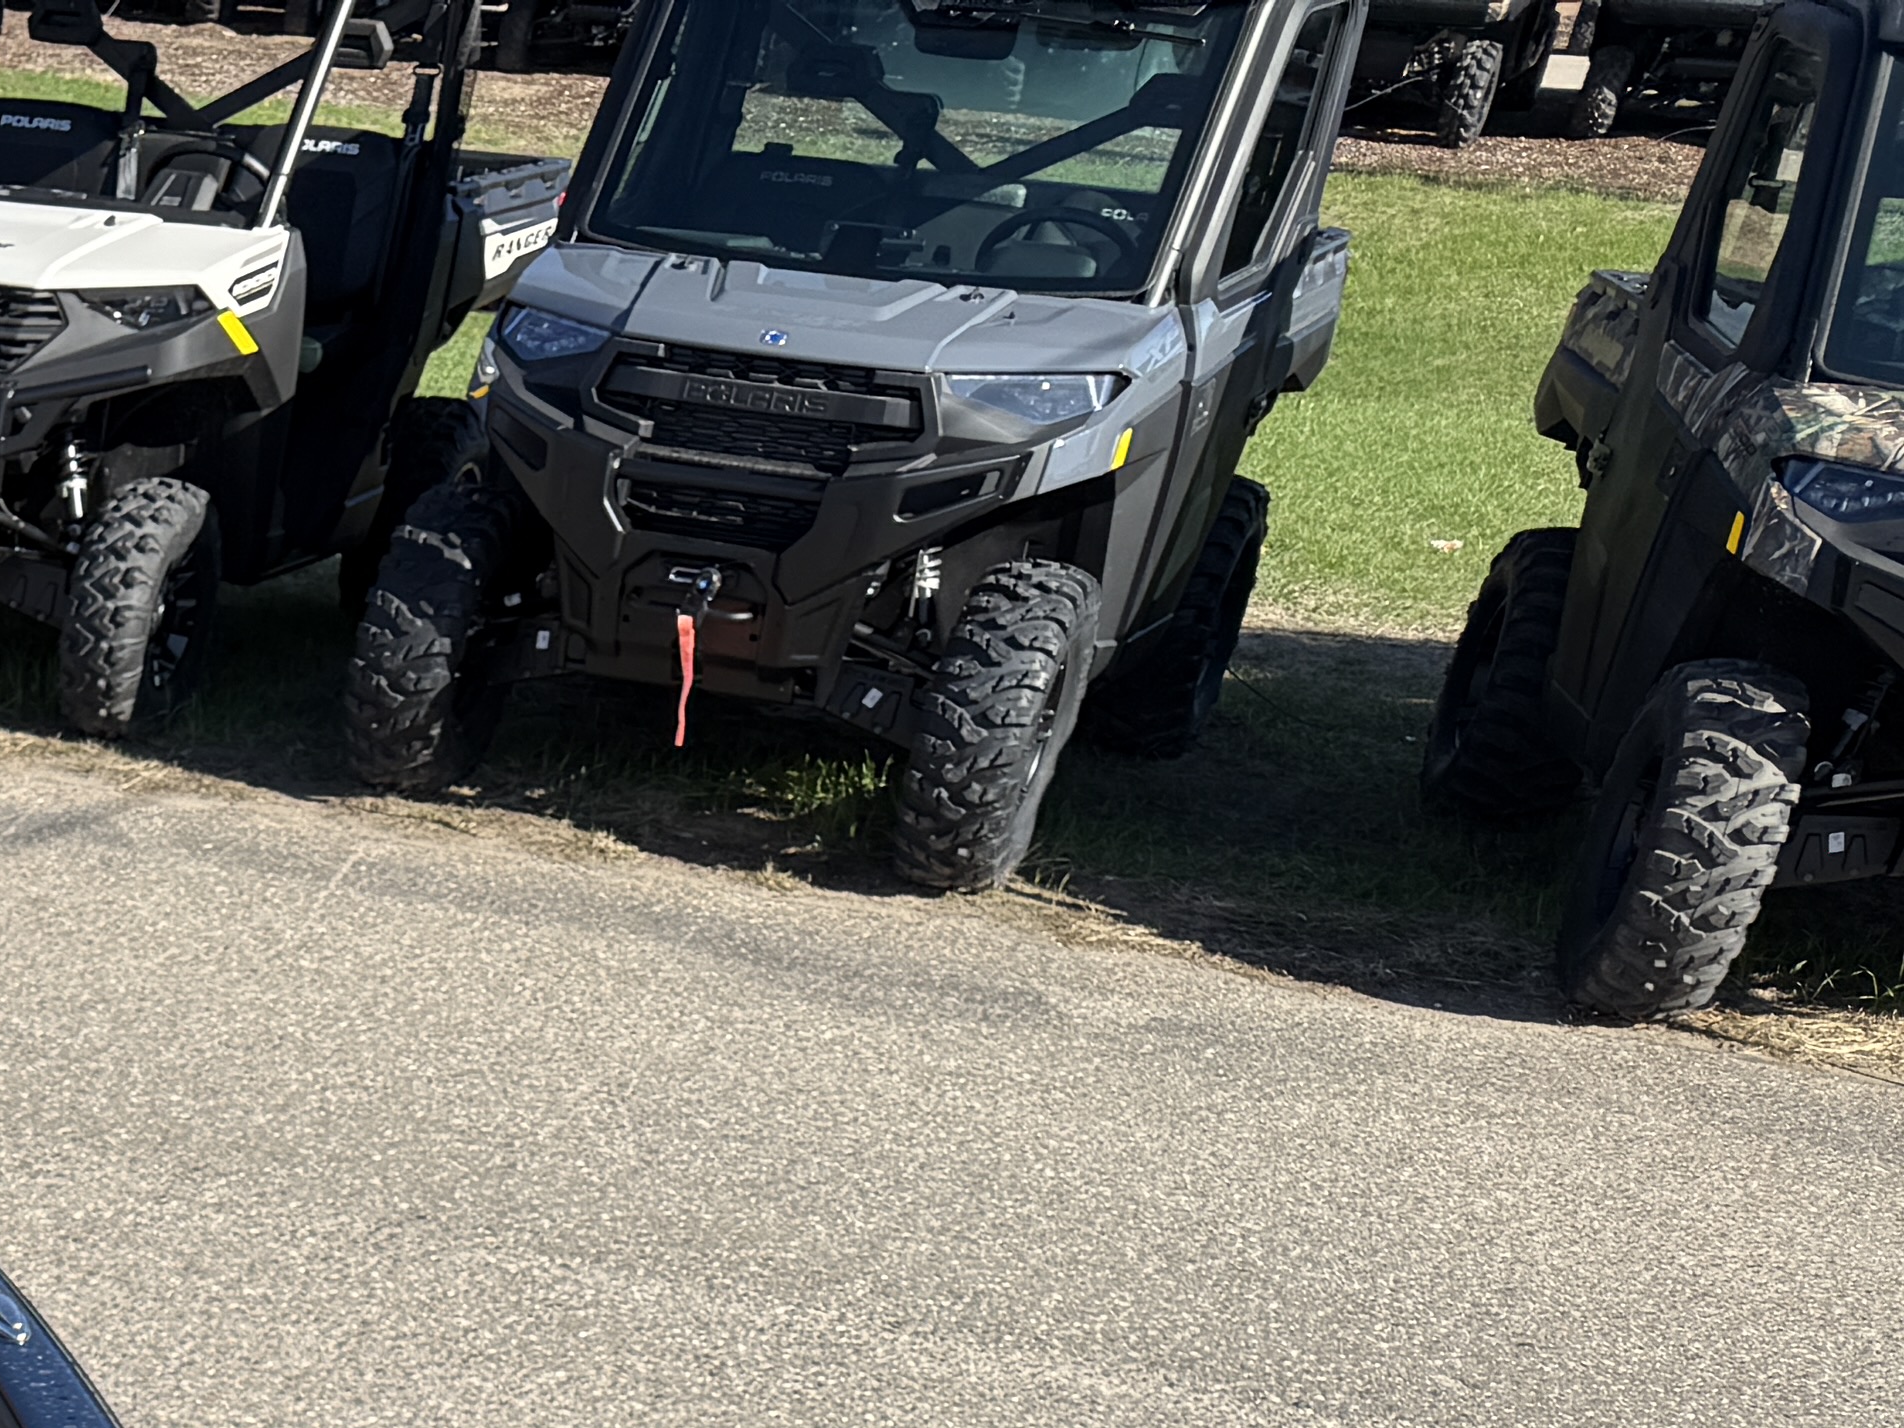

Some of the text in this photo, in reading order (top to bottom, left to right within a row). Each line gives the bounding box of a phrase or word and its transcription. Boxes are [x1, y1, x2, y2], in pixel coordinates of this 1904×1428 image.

[0, 114, 71, 132] POLARIS
[760, 170, 834, 187] POLARIS
[492, 226, 553, 261] RANGER
[682, 378, 830, 414] POLARIS
